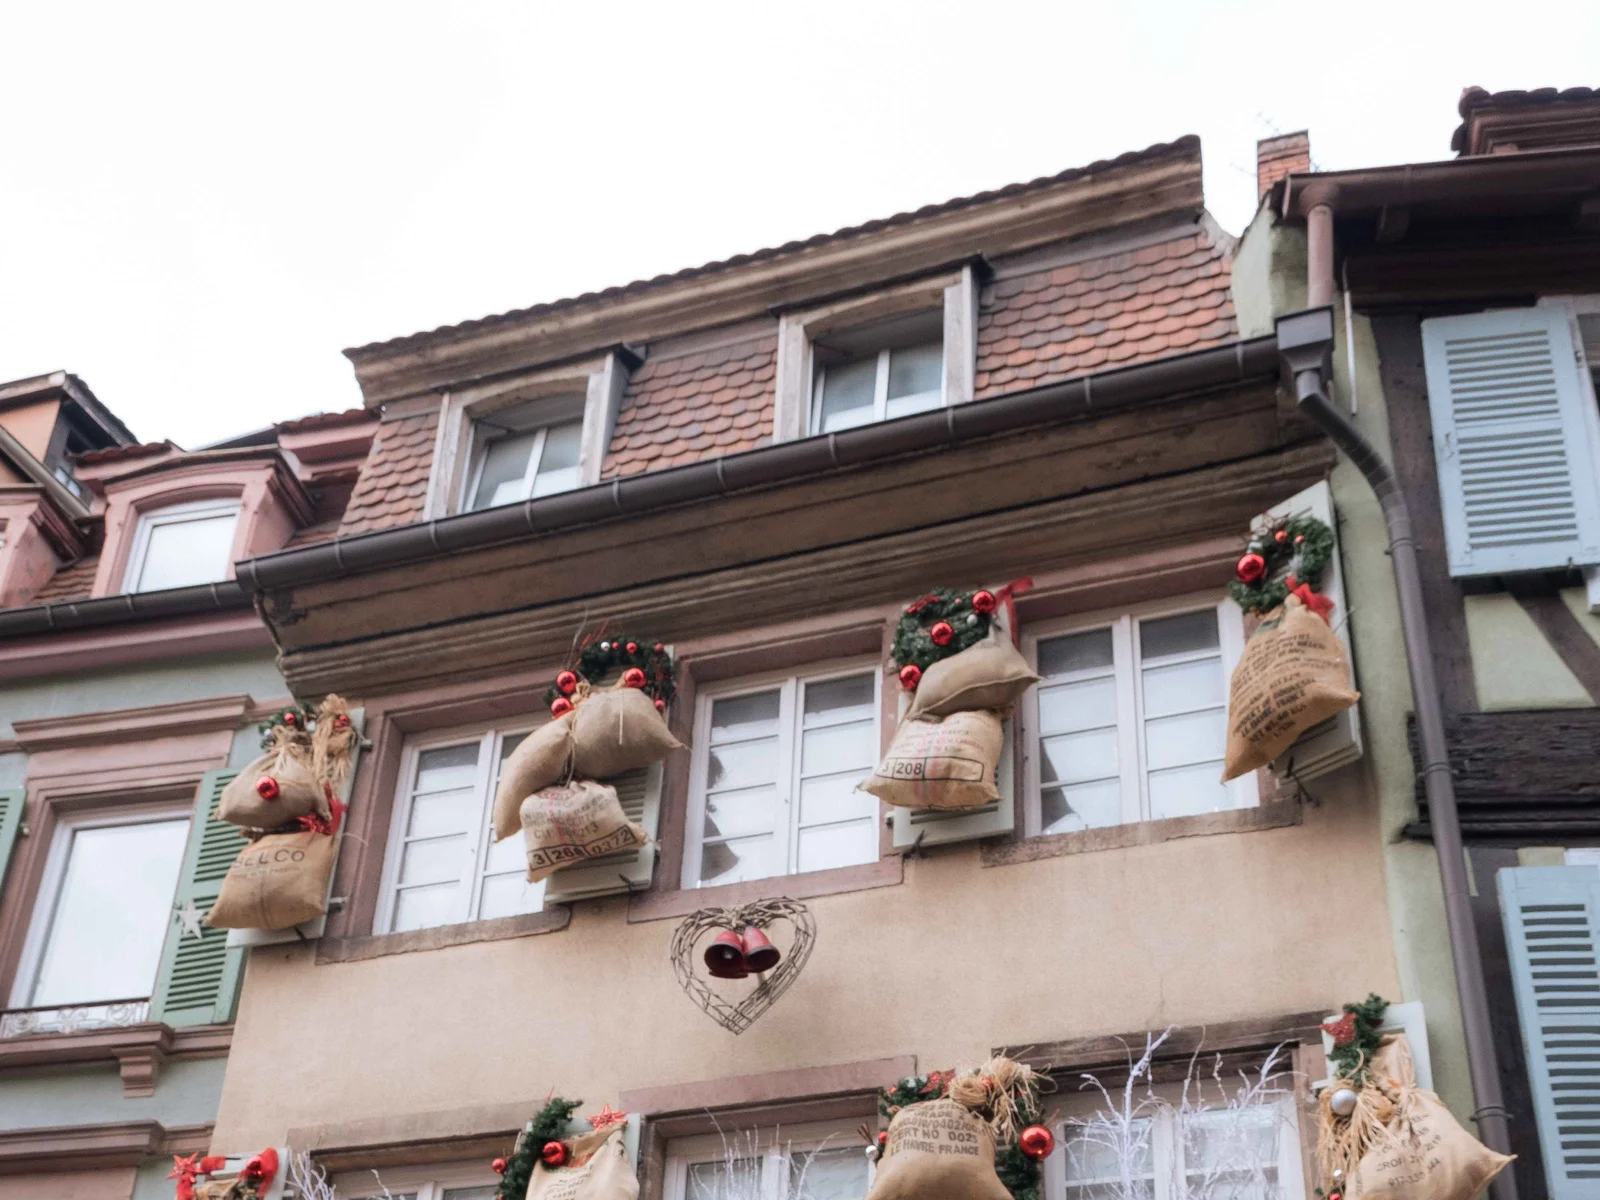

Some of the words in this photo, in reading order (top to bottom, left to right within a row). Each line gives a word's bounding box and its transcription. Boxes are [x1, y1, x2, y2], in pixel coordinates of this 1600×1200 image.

[895, 763, 923, 775] 208
[532, 853, 546, 866] 3
[903, 1139, 935, 1153] HAVRE
[939, 1144, 980, 1156] FRANCE
